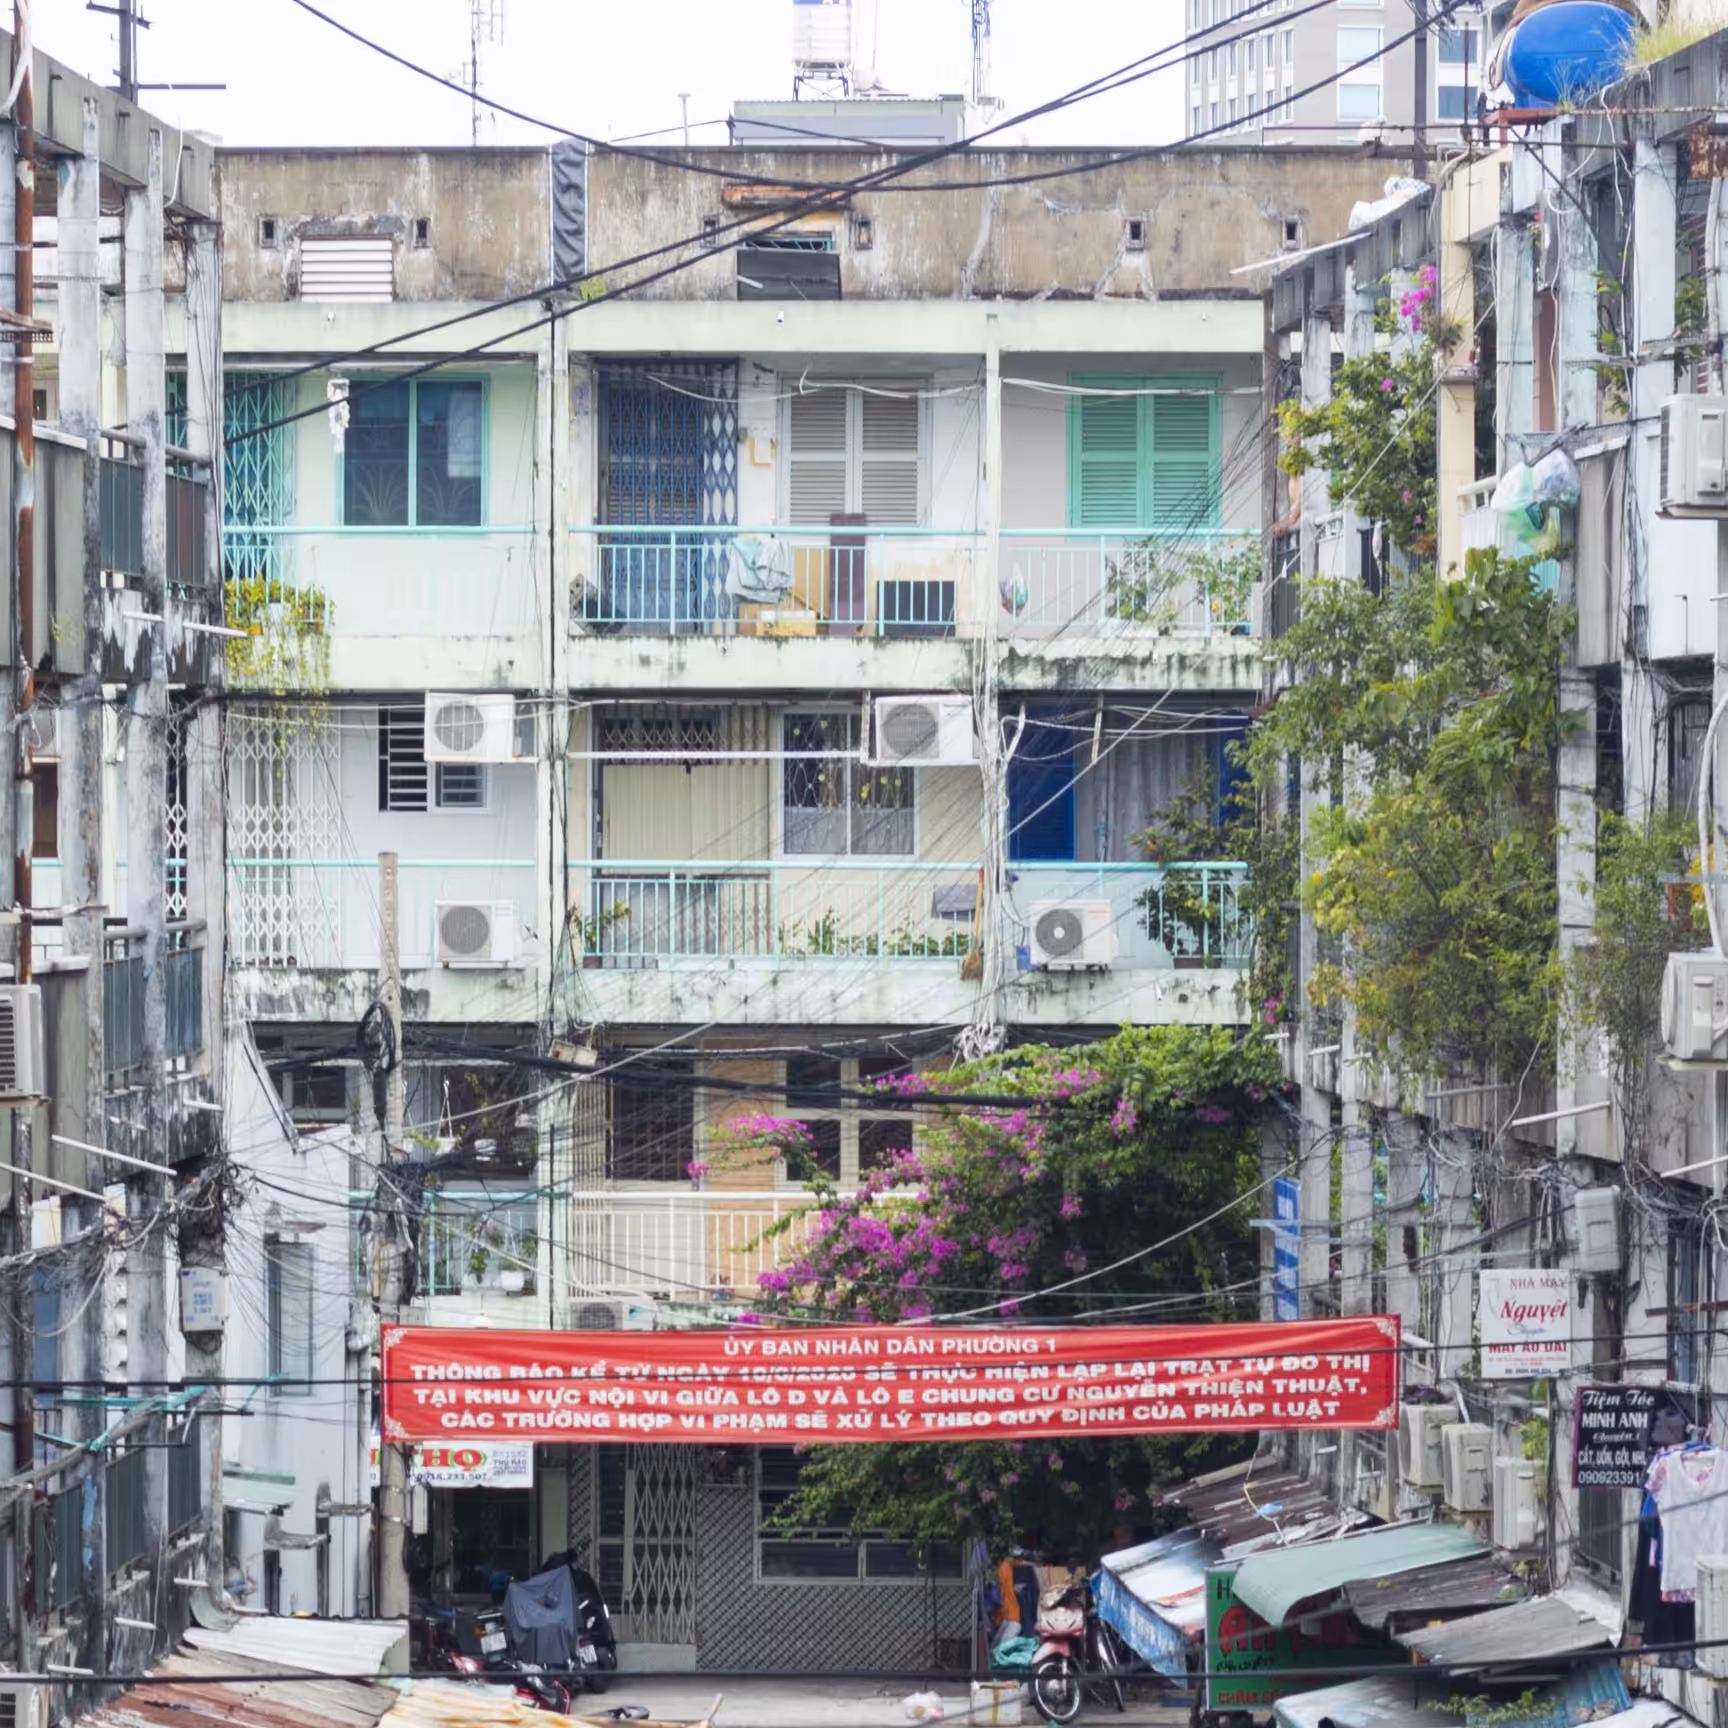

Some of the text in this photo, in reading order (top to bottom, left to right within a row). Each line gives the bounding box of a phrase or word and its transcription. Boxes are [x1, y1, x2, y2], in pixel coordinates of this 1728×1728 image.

[1501, 1297, 1568, 1323] Nguyệt
[724, 1336, 1056, 1355] ỦY BAN NHÂN DÂN PHƯỜNG 1
[410, 1363, 501, 1380] THÔNG
[657, 1363, 729, 1381] NGÀY
[864, 1361, 897, 1381] SẼ
[906, 1362, 977, 1383] THỰC
[985, 1362, 1051, 1383] HIỆN
[1114, 1361, 1155, 1381] LẠI
[1326, 1353, 1370, 1372] THỊ
[413, 1375, 1368, 1409] TẠI KHU VỰC NỘI VI GIỮA LÔ D VÀ LÔ E CHUNG CƯ NGUYỄN THIỆN THUẬT,
[1583, 1389, 1655, 1410] Tiệm Tóc
[441, 1400, 1341, 1432] CÁC TRƯỜNG HỢP VI PHẠM SẼ XỬ LÝ THEO QUY ĐỊNH CỦA PHÁP LUẬT
[1582, 1412, 1648, 1428] MINH ANH
